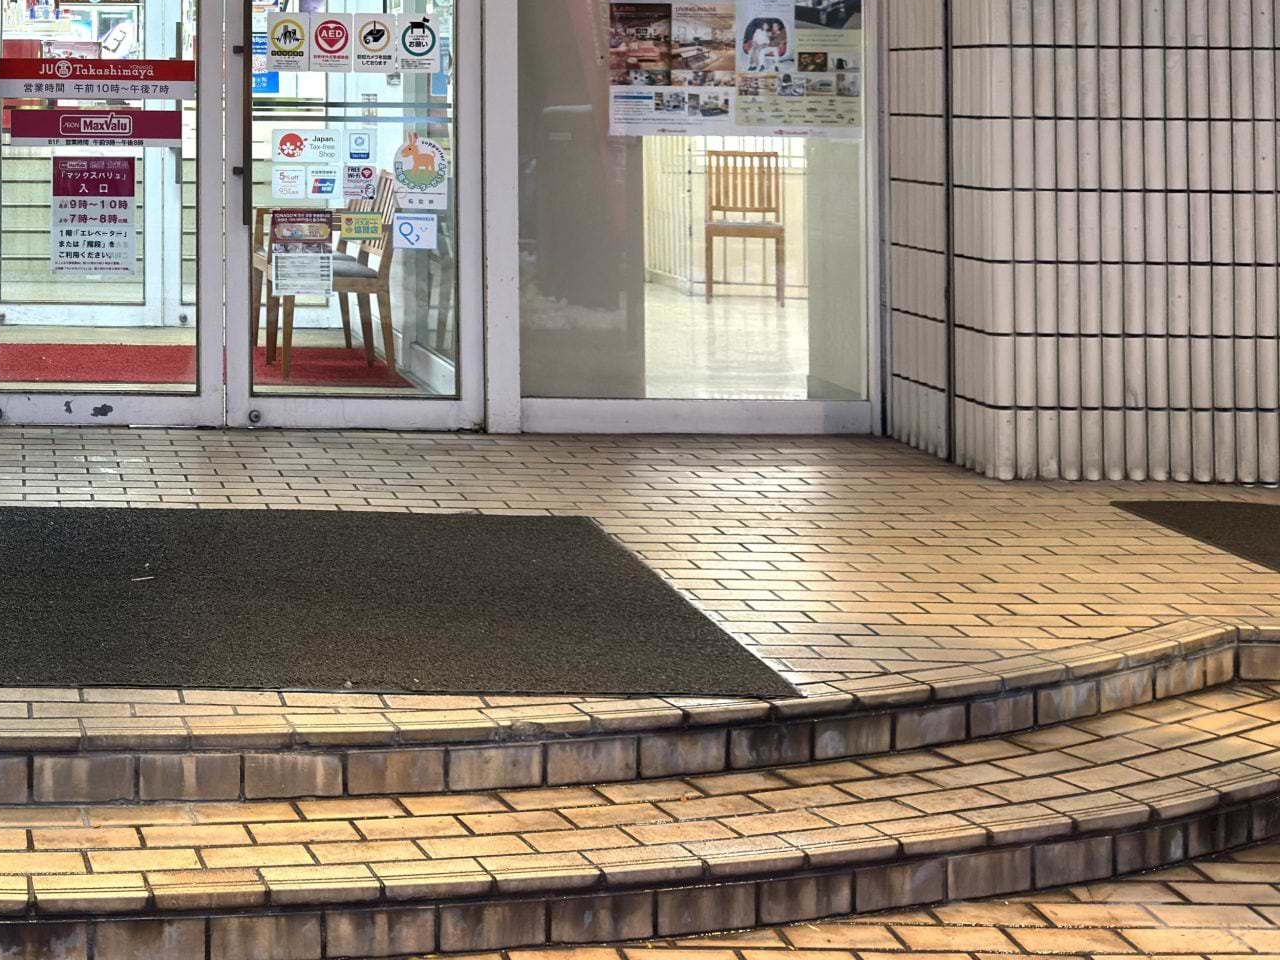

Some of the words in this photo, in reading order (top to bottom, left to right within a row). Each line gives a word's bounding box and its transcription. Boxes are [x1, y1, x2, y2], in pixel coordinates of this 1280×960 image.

[321, 29, 343, 38] AED
[38, 63, 54, 74] JU
[73, 64, 155, 78] Takashimaya
[23, 83, 65, 93] 営業時間
[83, 113, 127, 131] MaxValu
[59, 230, 127, 238] 1階「エレベーター」
